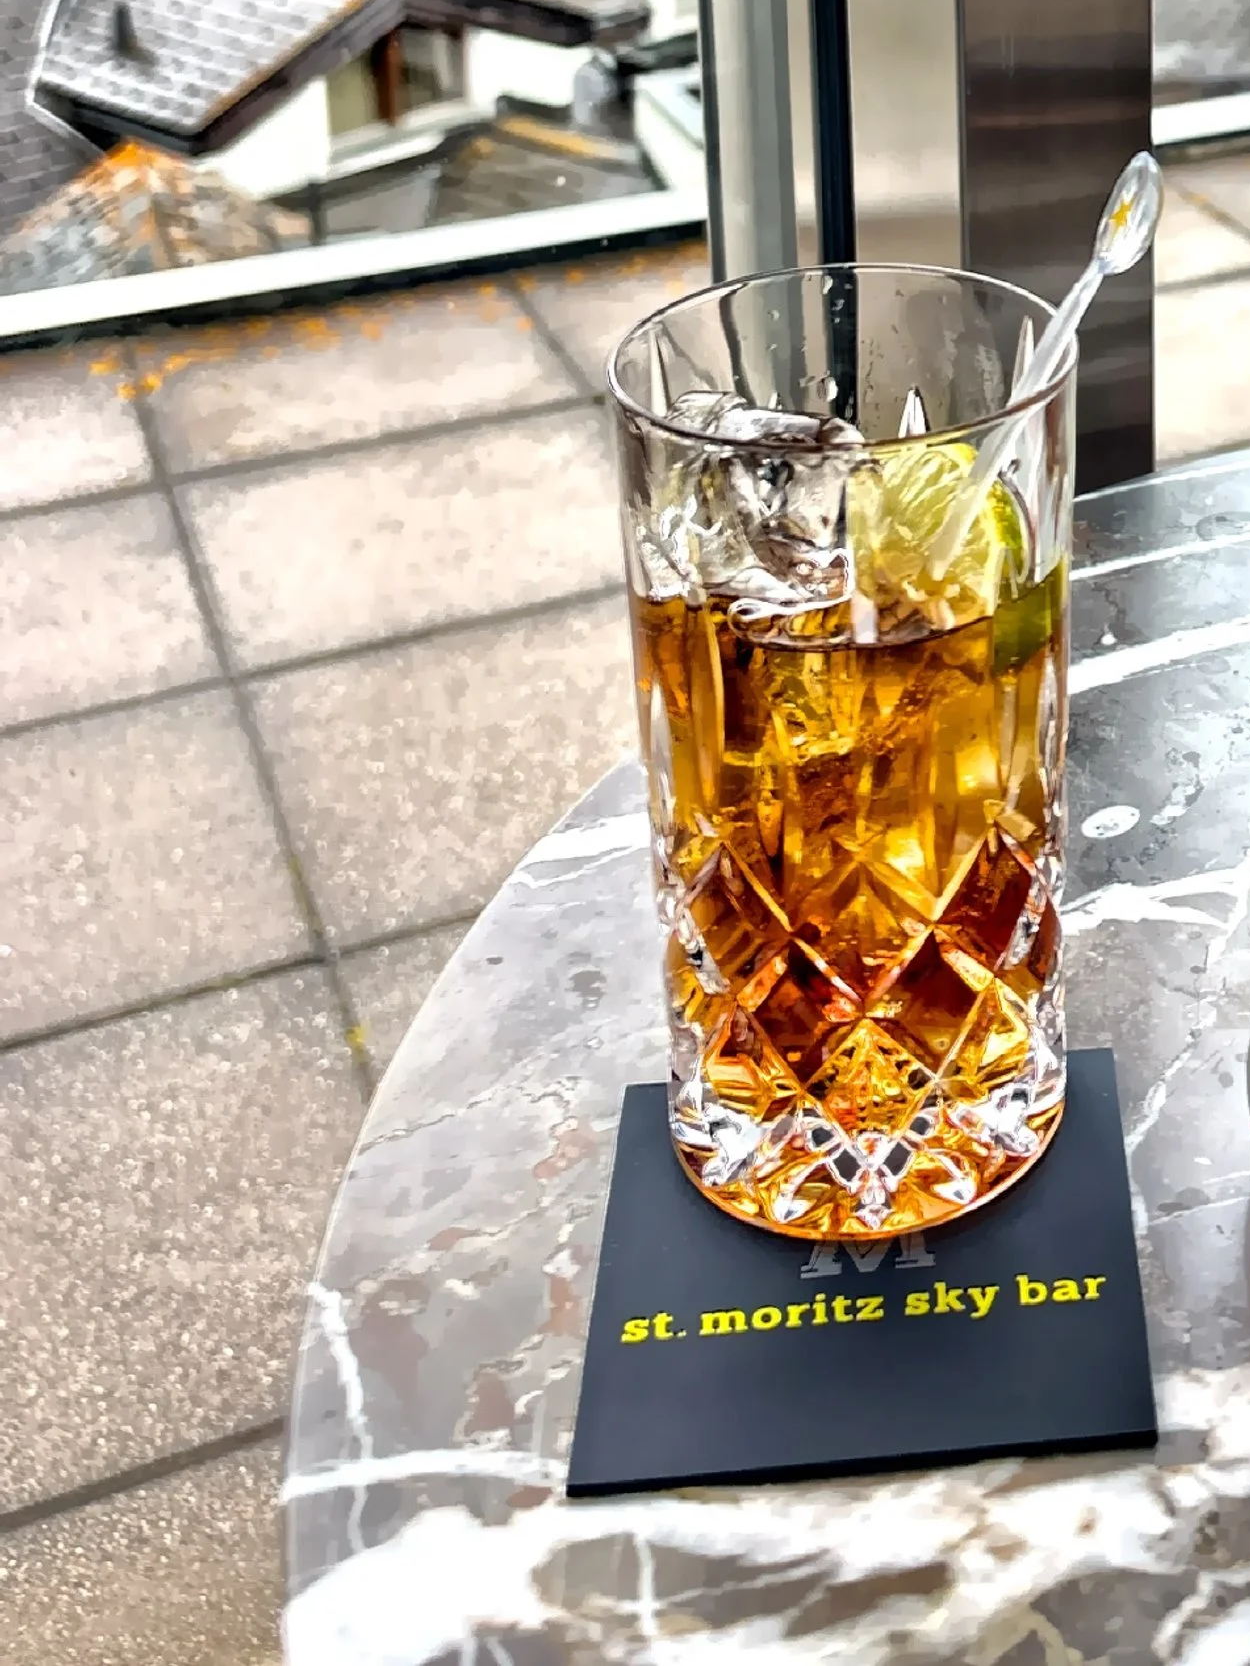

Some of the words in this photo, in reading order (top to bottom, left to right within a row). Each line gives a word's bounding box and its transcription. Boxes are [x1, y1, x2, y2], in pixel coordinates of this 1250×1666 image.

[621, 1312, 687, 1343] st.
[700, 1293, 884, 1335] moritz
[905, 1281, 1000, 1319] sky
[1016, 1274, 1106, 1306] bar
